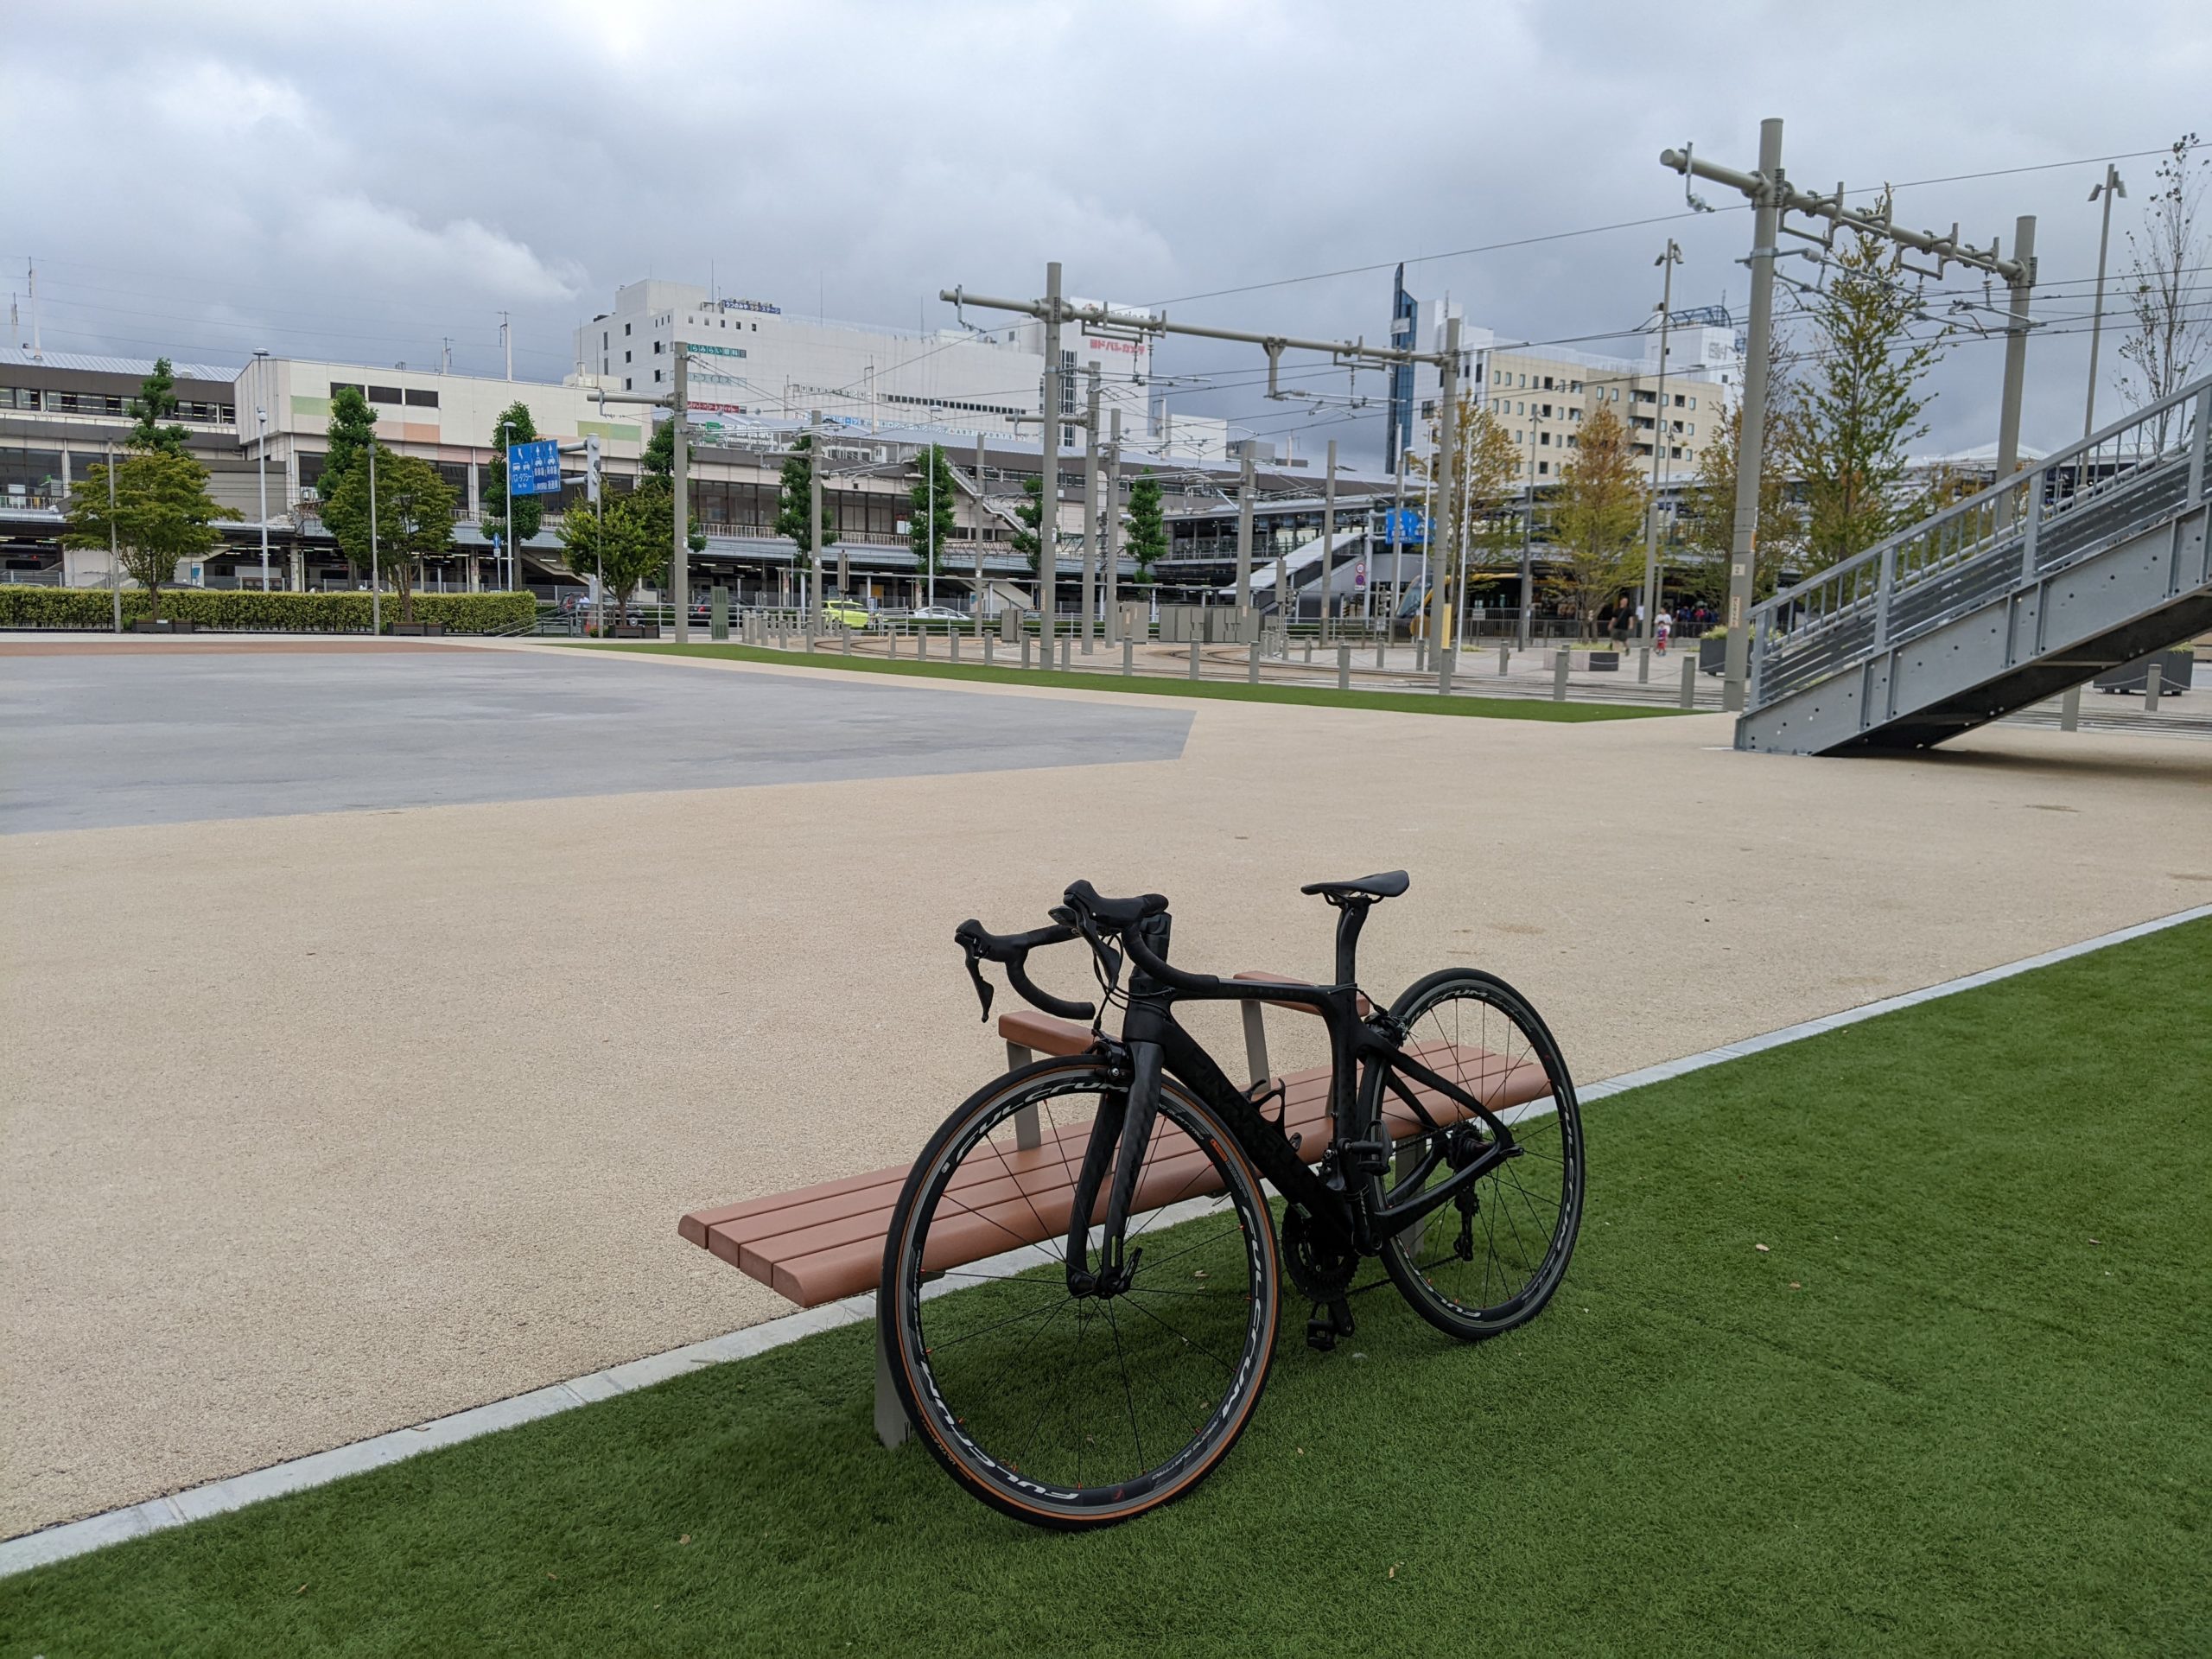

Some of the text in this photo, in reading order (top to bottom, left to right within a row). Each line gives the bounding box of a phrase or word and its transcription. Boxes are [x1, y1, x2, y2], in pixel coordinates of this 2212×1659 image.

[1407, 989, 1488, 1030] ULCRUM
[957, 1083, 1129, 1163] FULCRUM
[1223, 1205, 1262, 1419] FULCRUM
[1395, 1234, 1481, 1318] FULCRU
[920, 1361, 1079, 1500] FULCRUM
